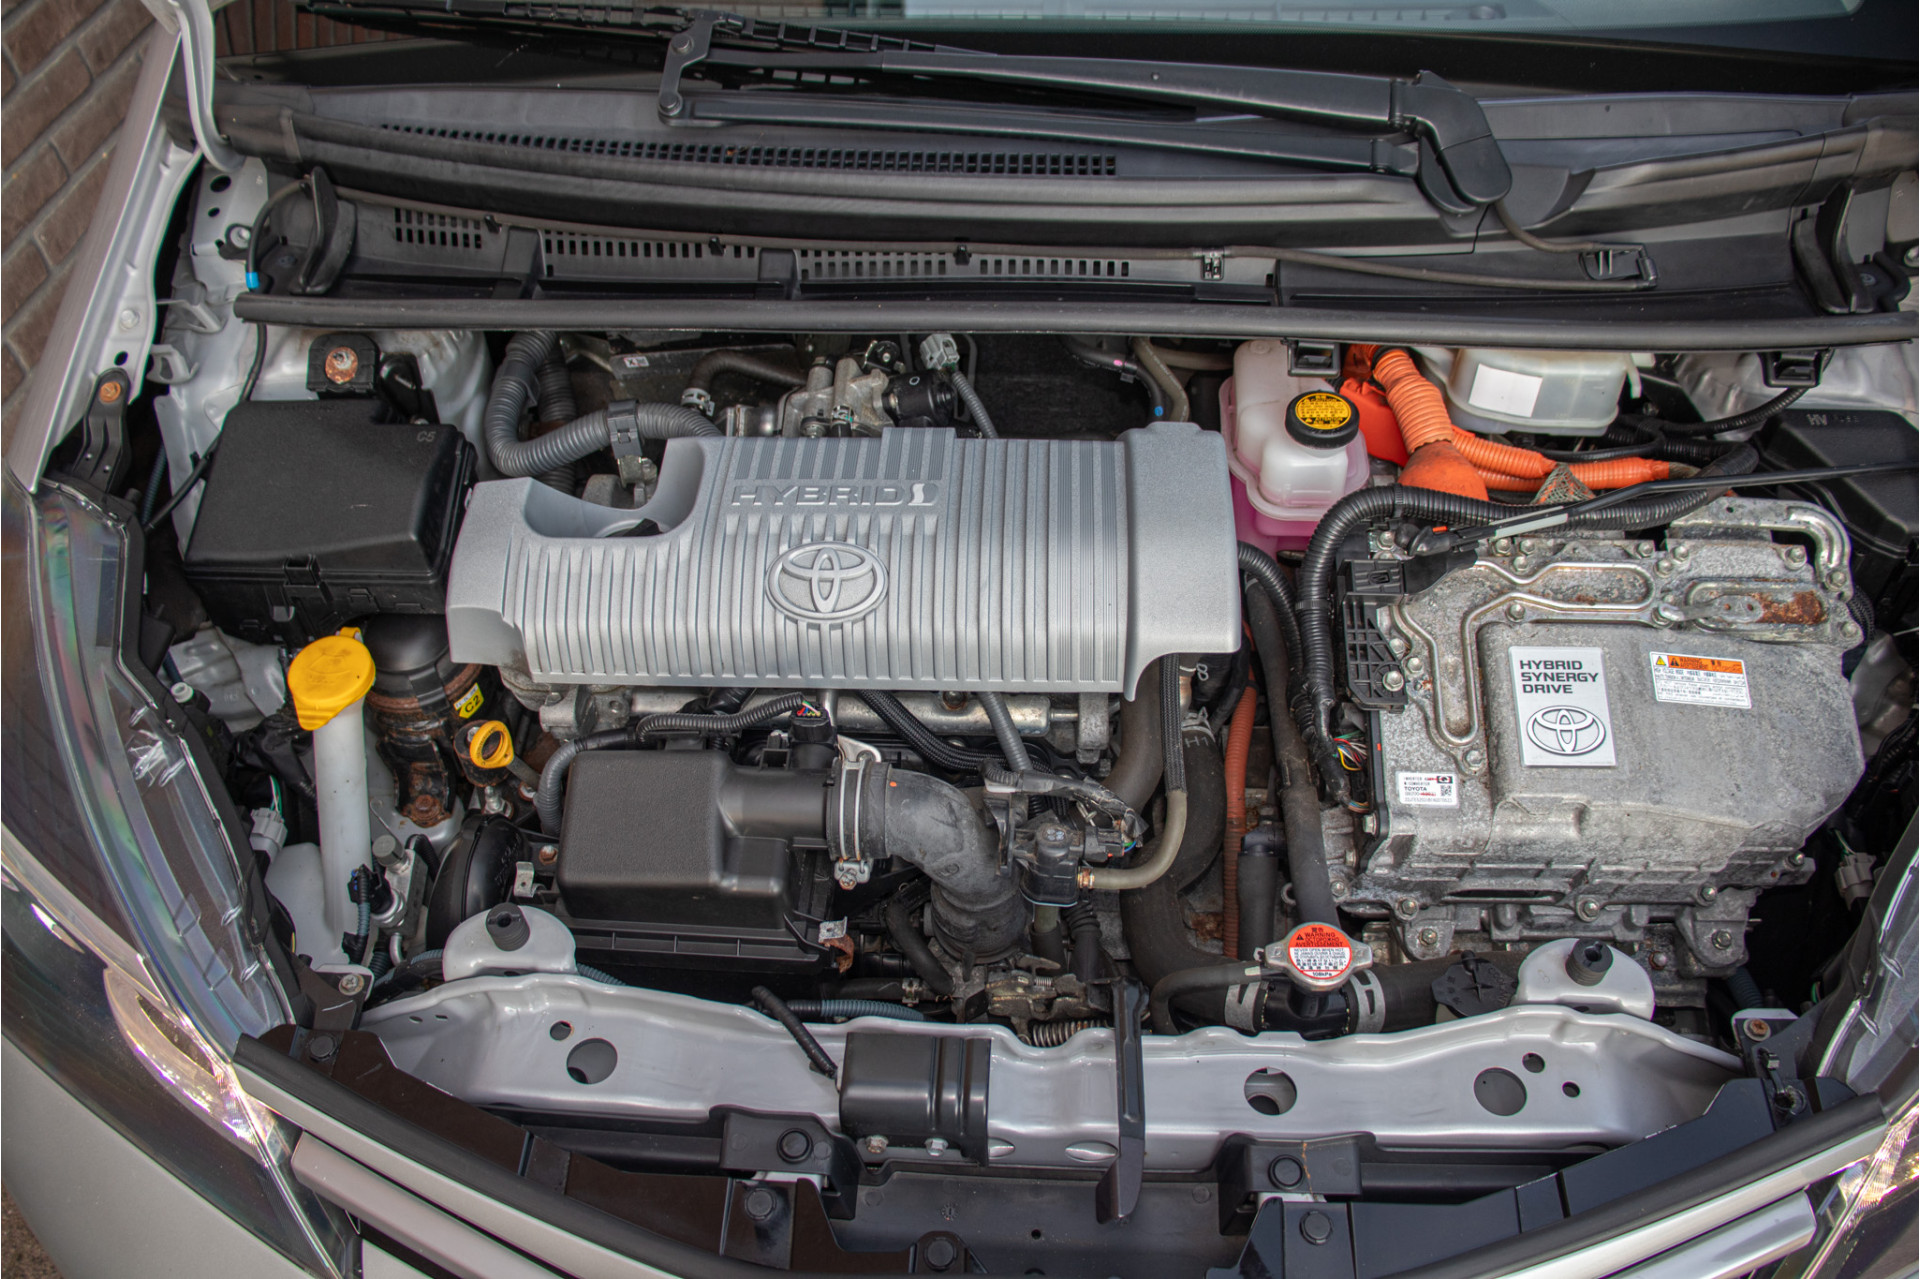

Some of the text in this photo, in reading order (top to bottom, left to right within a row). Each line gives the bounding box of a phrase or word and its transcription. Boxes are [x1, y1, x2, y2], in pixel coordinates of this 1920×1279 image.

[731, 485, 906, 506] HYBRID
[1519, 660, 1583, 670] HYBRID
[1521, 672, 1599, 682] SYNERGY
[1522, 684, 1573, 694] DRIVE
[465, 694, 481, 712] C2
